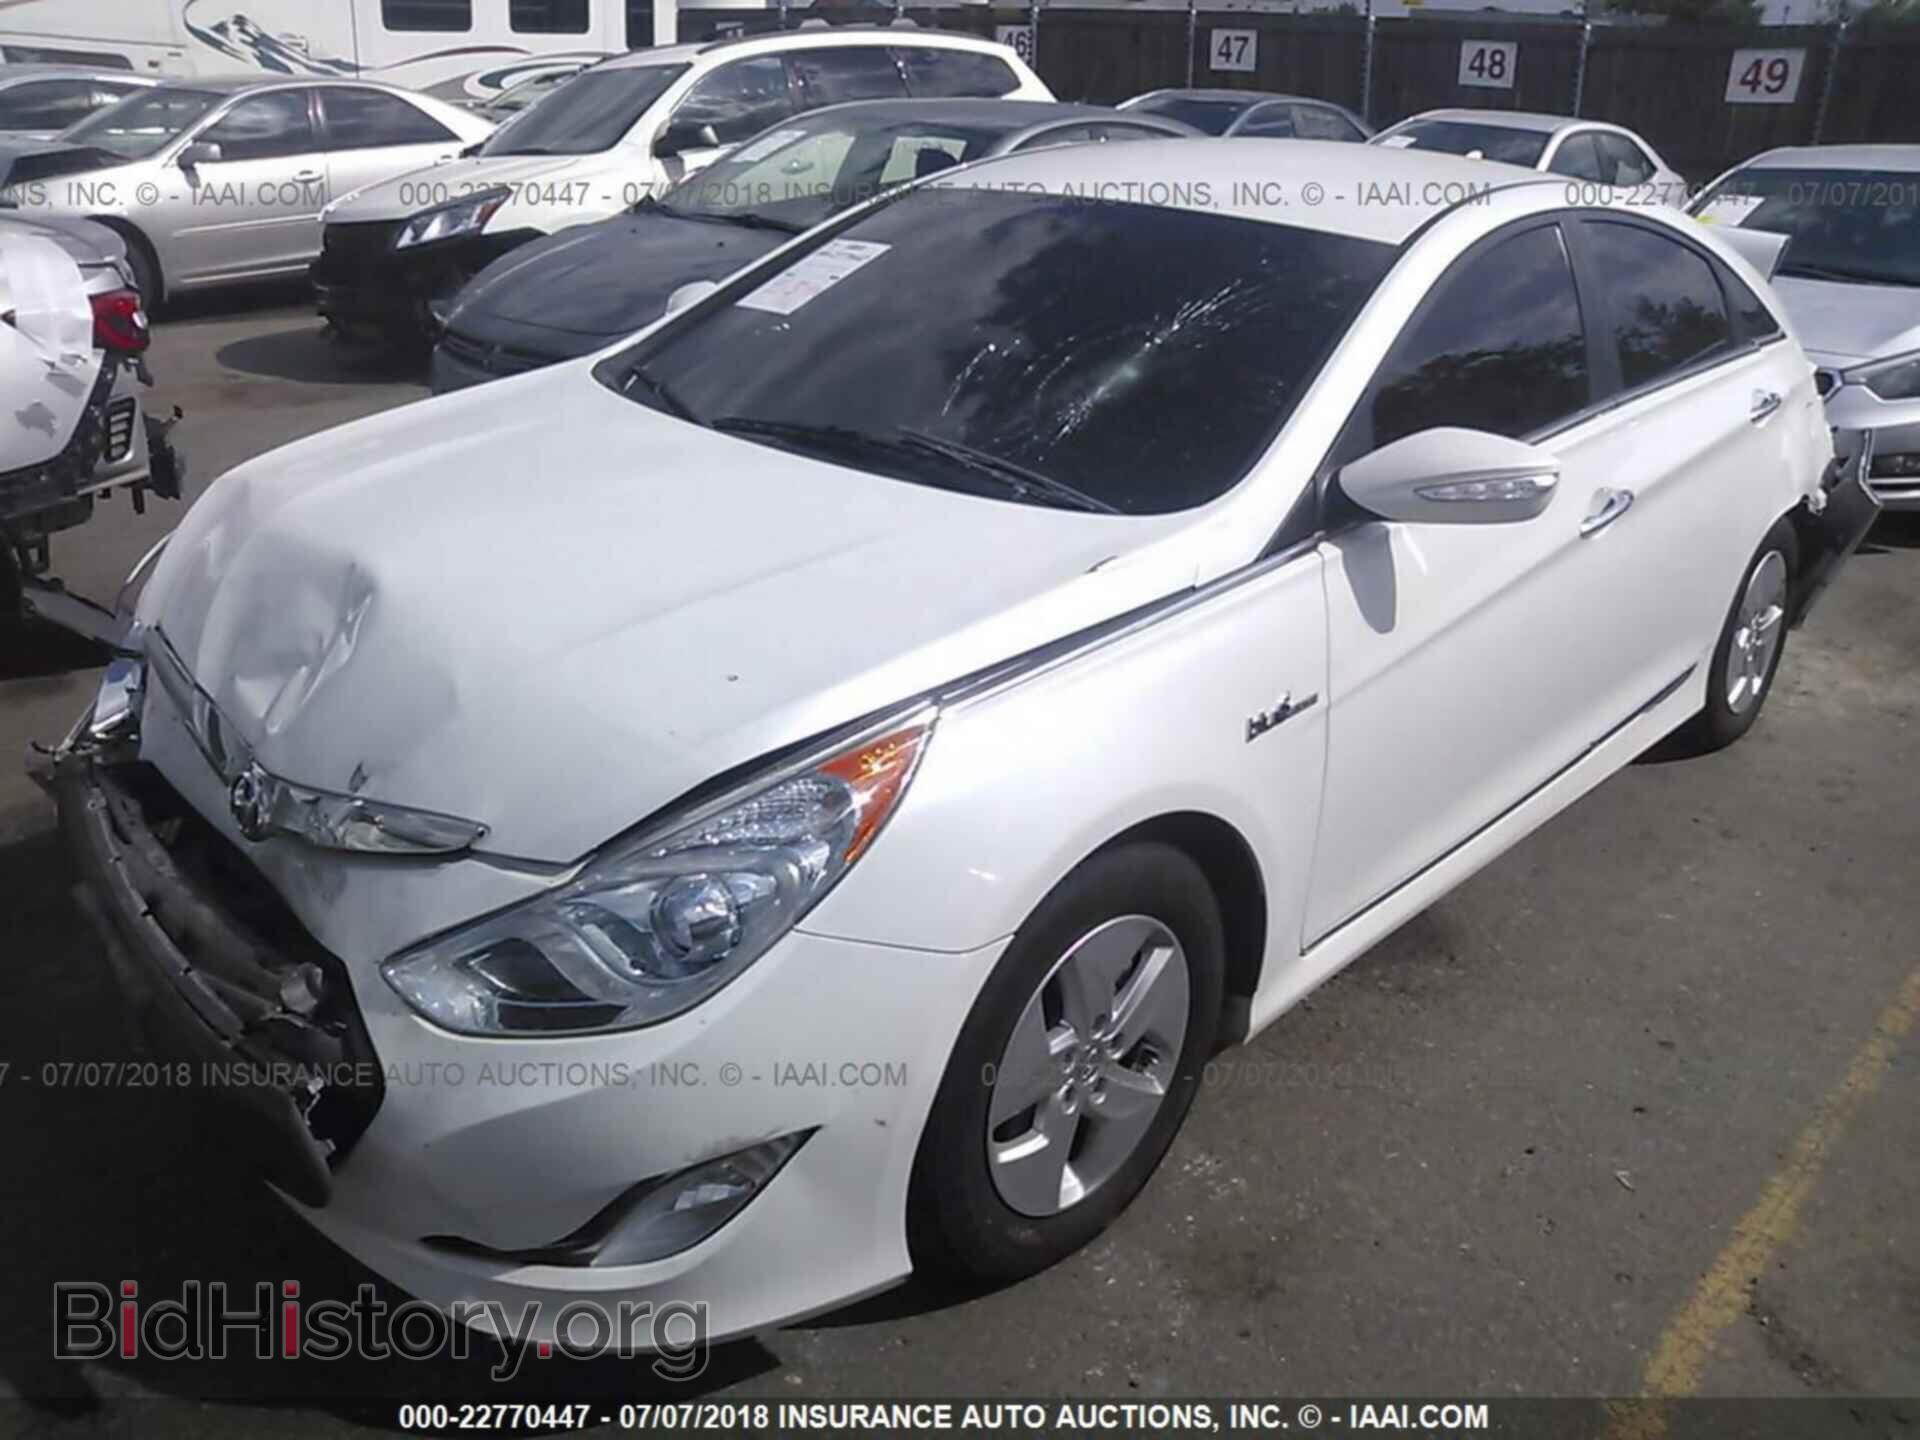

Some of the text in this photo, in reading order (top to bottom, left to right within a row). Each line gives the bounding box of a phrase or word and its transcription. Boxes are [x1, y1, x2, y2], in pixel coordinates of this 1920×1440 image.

[1217, 35, 1249, 63] 47
[1468, 47, 1506, 79] 48
[1739, 57, 1790, 94] 49
